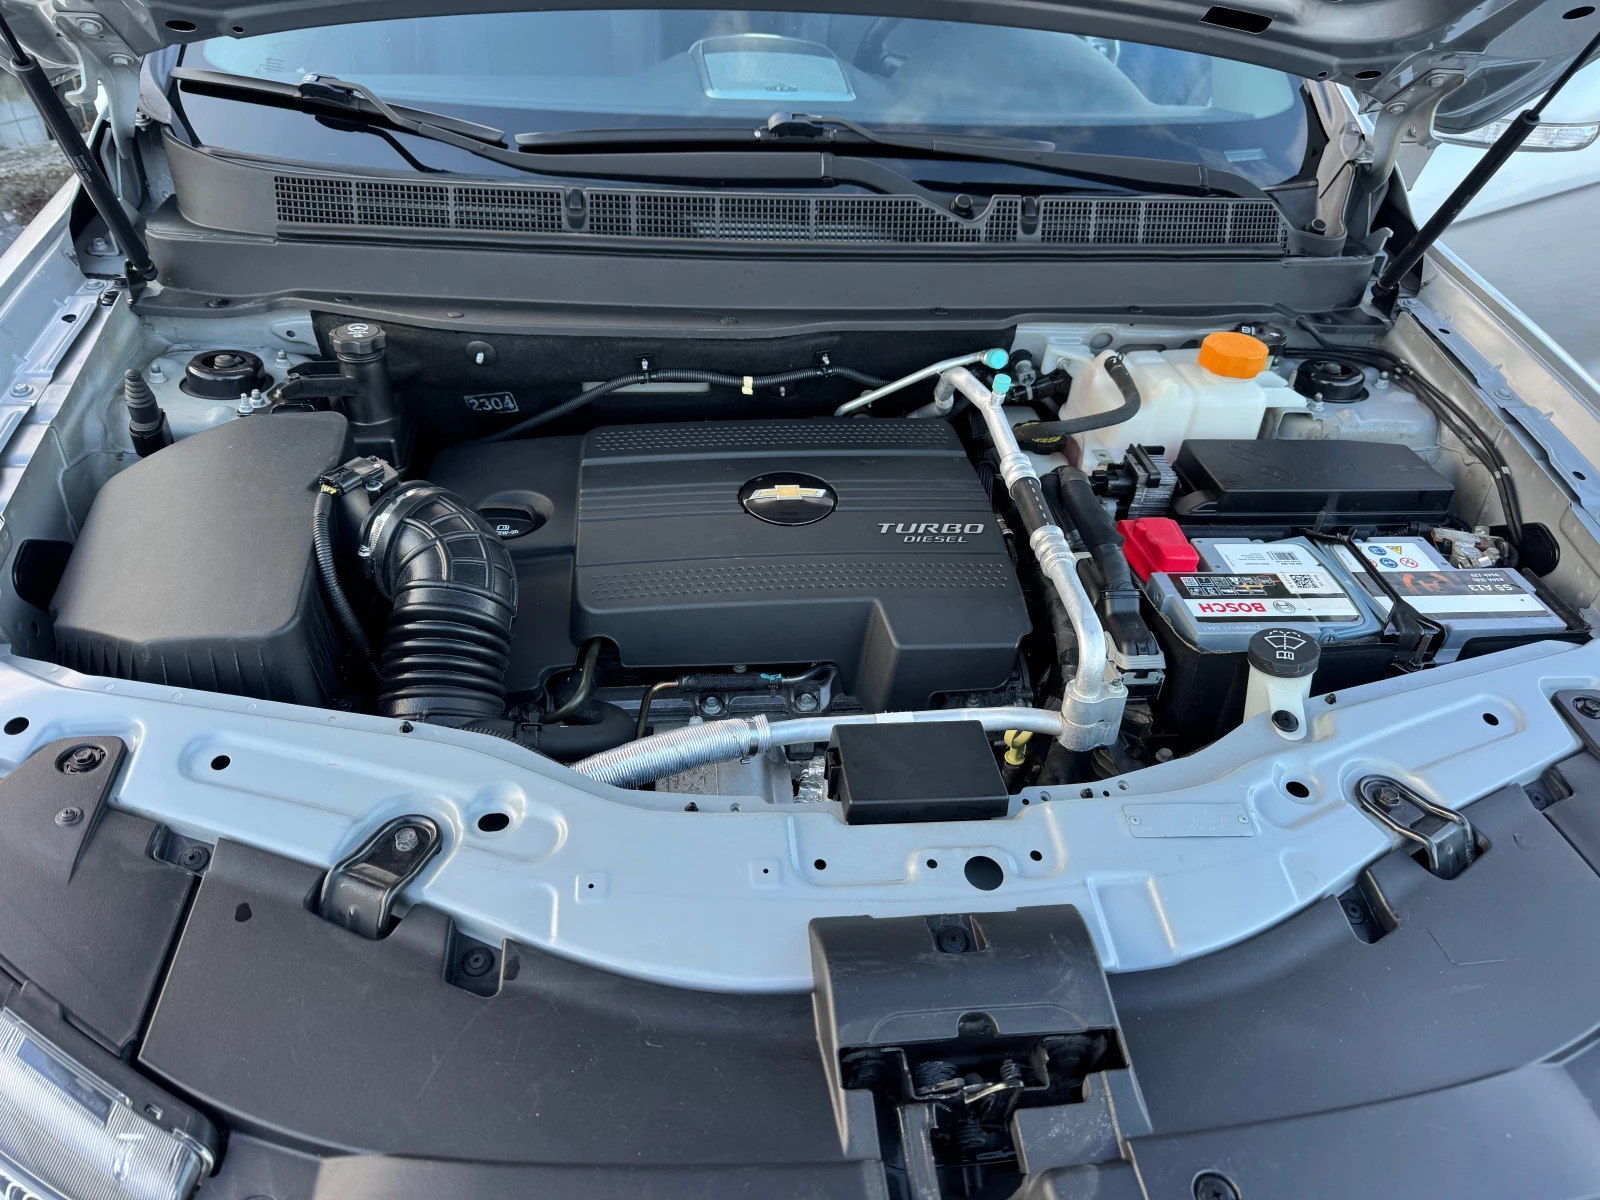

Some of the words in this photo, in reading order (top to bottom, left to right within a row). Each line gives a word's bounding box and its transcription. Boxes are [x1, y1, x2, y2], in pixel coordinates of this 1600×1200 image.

[468, 395, 515, 411] 2304
[877, 523, 985, 534] TURBO
[903, 535, 968, 543] DIESEL
[1197, 602, 1267, 613] BOSCH
